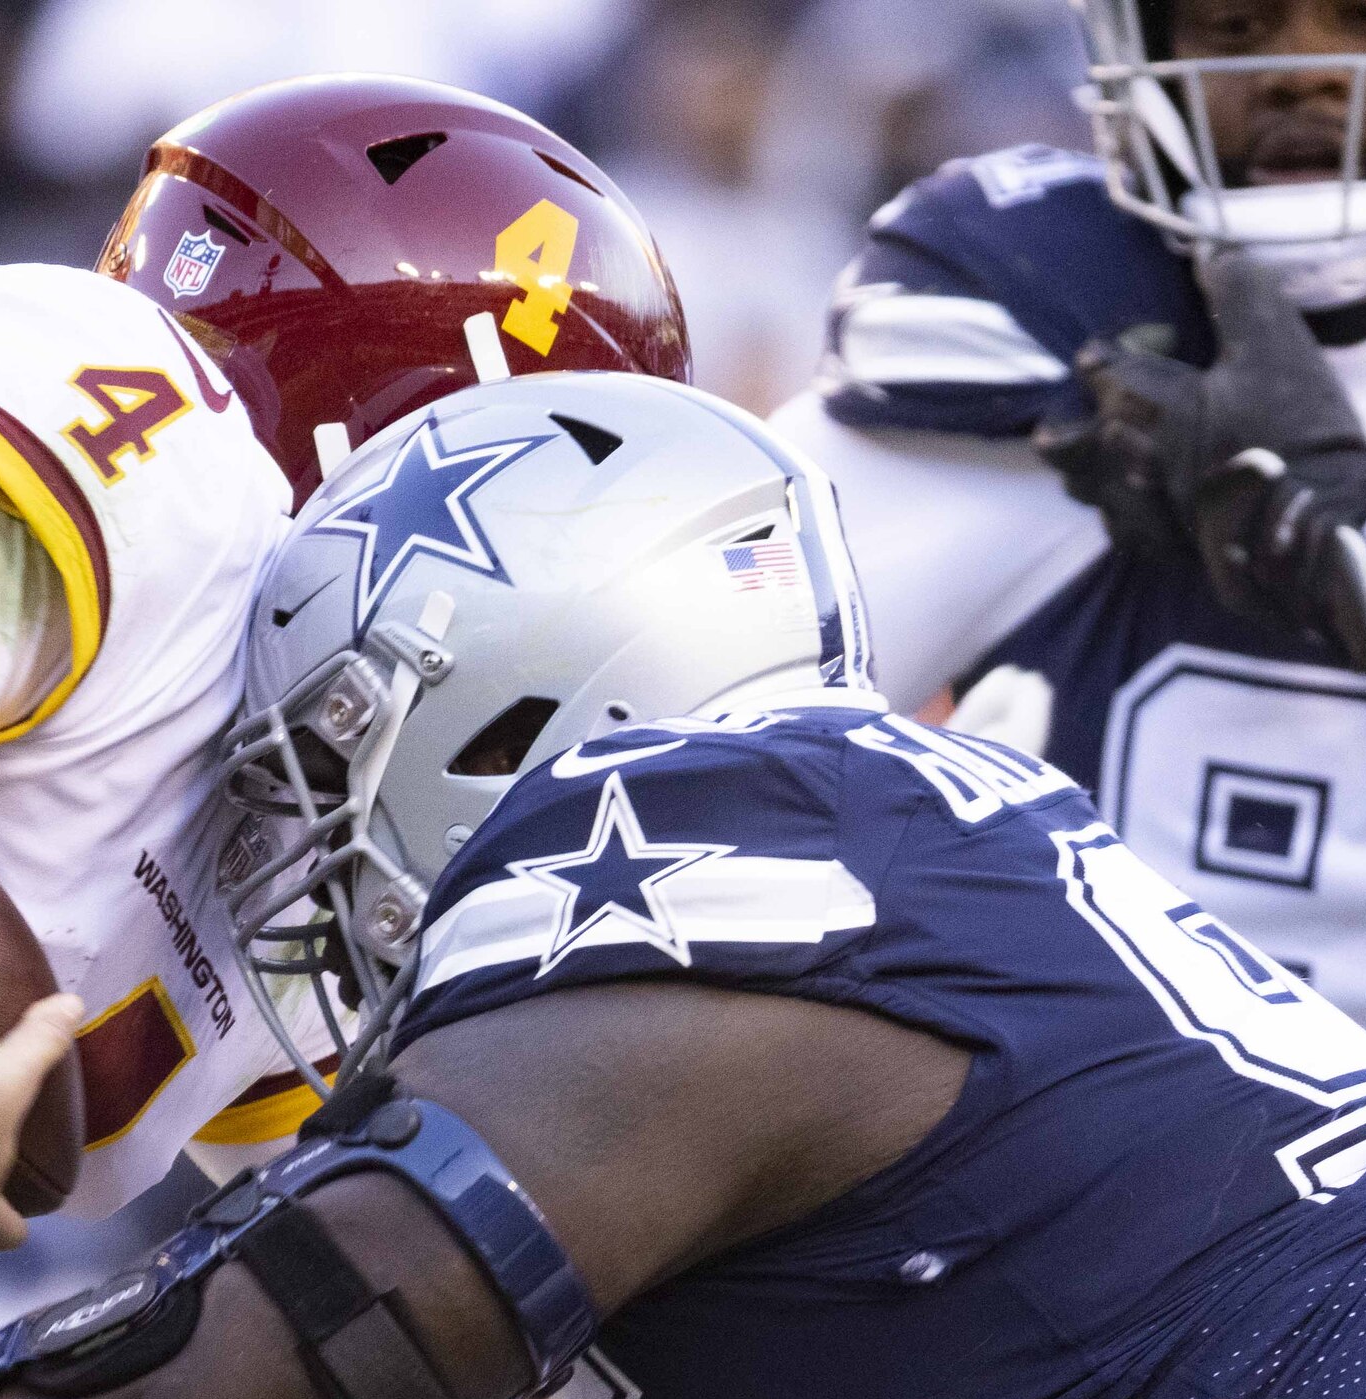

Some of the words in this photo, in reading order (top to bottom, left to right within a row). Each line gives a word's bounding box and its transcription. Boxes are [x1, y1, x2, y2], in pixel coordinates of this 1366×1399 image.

[495, 198, 579, 357] 4
[61, 363, 195, 489] 4
[134, 848, 236, 1041] WASHINGTON
